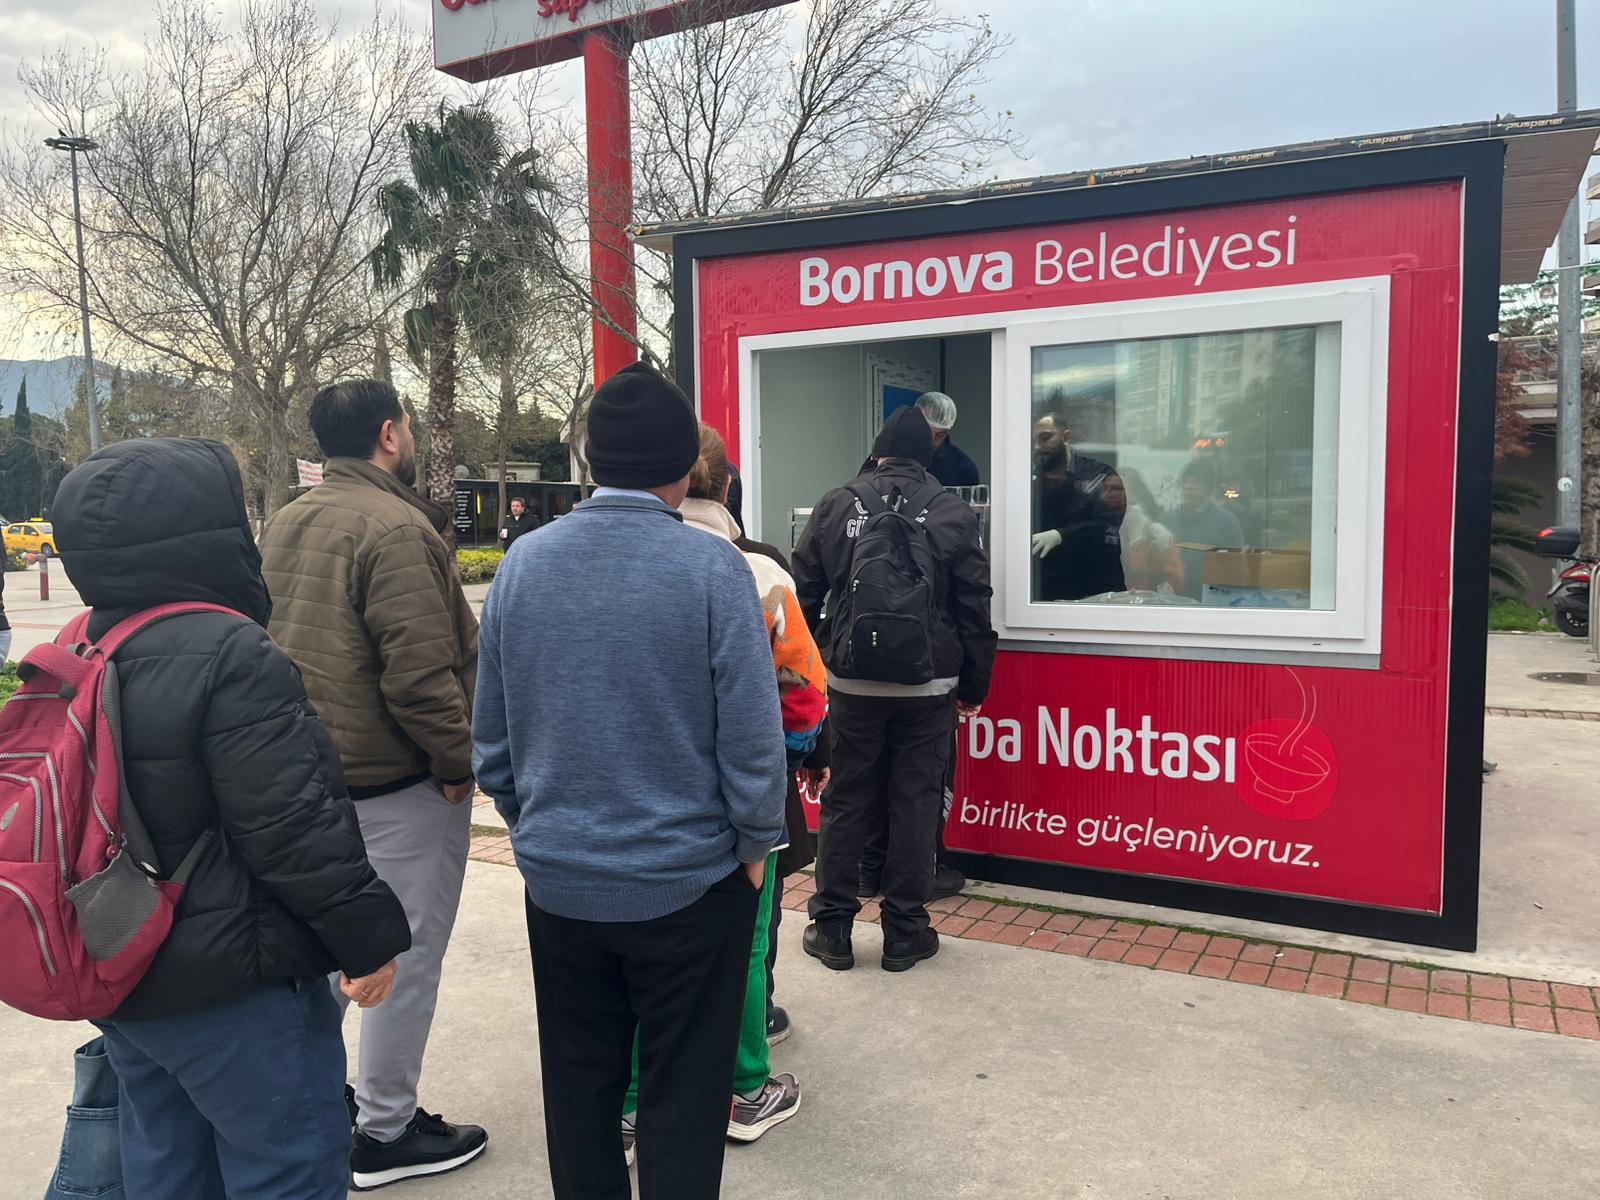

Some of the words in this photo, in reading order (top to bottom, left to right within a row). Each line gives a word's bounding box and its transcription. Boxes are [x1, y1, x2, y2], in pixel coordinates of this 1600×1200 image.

[799, 250, 1013, 307] Bornova
[1034, 215, 1297, 287] Belediyesi
[1038, 705, 1236, 783] Noktası
[960, 797, 1067, 835] birlikte
[1077, 814, 1320, 868] güçleniyoruz.
